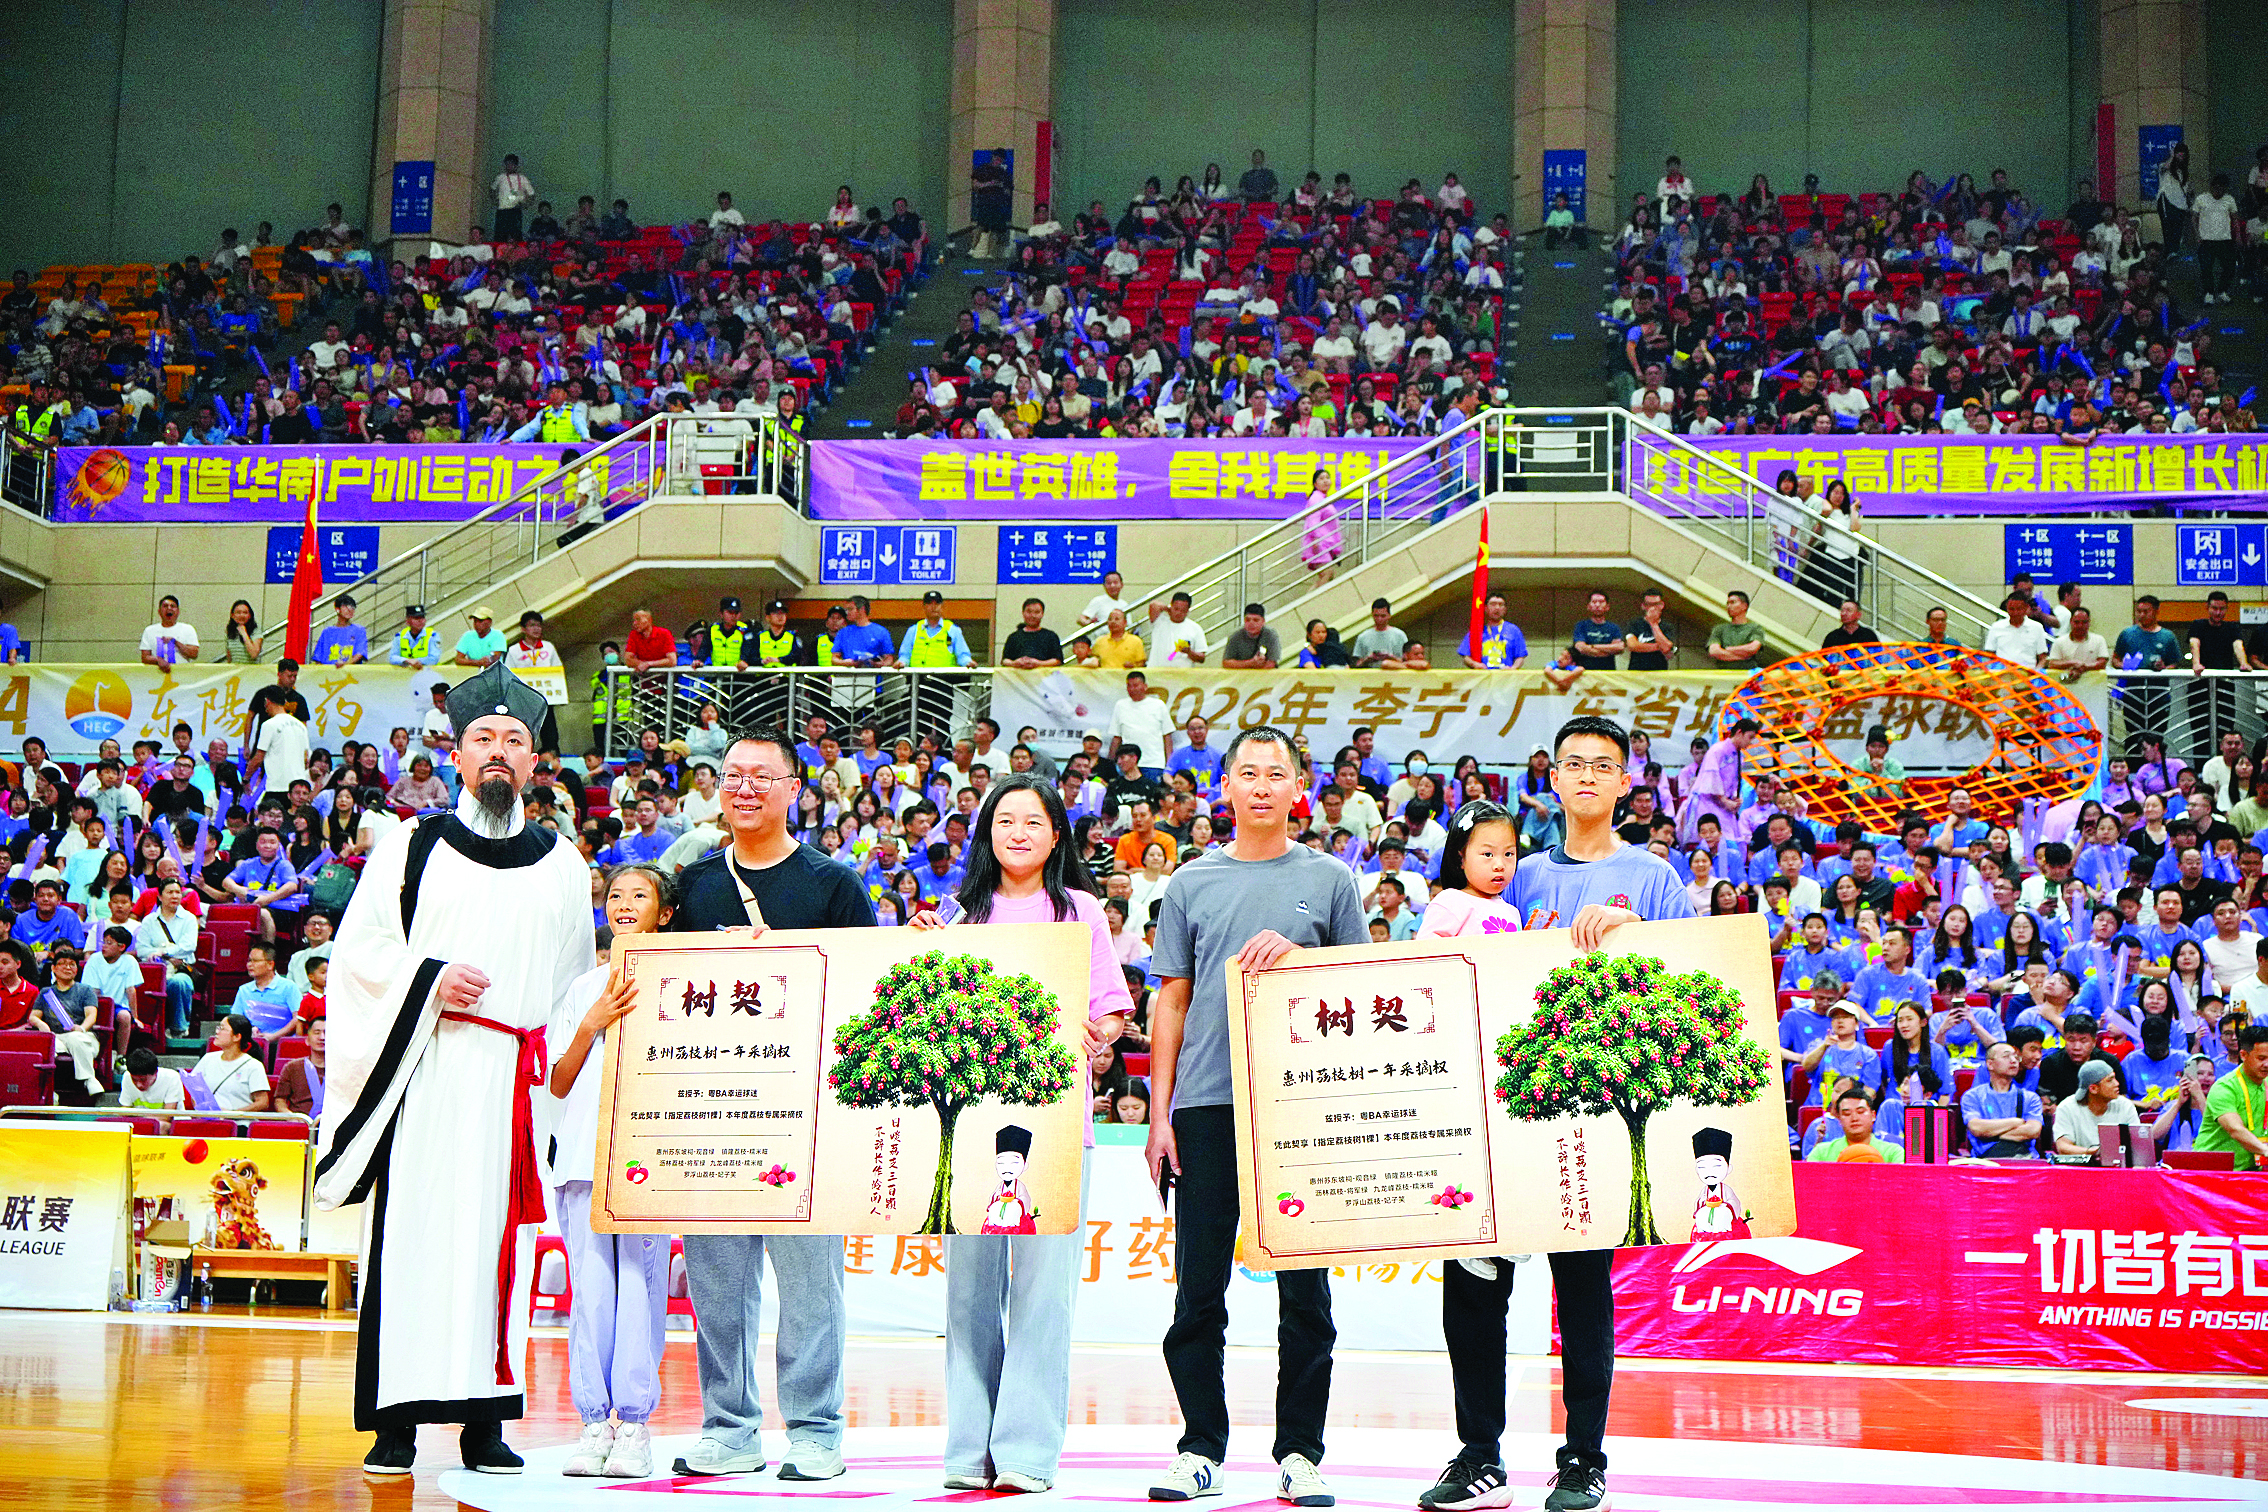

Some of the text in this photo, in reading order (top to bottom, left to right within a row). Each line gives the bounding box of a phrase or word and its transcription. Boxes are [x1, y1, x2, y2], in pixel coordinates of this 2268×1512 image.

[828, 558, 871, 570] 安全出口
[909, 558, 946, 570] 卫生间
[2185, 558, 2233, 570] 安全出口
[837, 571, 860, 579] EXIT
[911, 571, 942, 579] TOILET
[2197, 571, 2221, 580] EXIT
[83, 721, 111, 734] HEC
[681, 979, 763, 1018] 树契
[1314, 994, 1409, 1038] 树契
[646, 1043, 791, 1062] 惠州荔枝树一年采摘权
[1282, 1059, 1449, 1087] 惠州荔枝树一年采摘权
[0, 1195, 74, 1233] 联赛
[0, 1240, 66, 1256] LEAGUE
[1672, 1285, 1864, 1317] LI-NING
[2039, 1306, 2153, 1327] ANYTHING
[2159, 1308, 2184, 1328] IS
